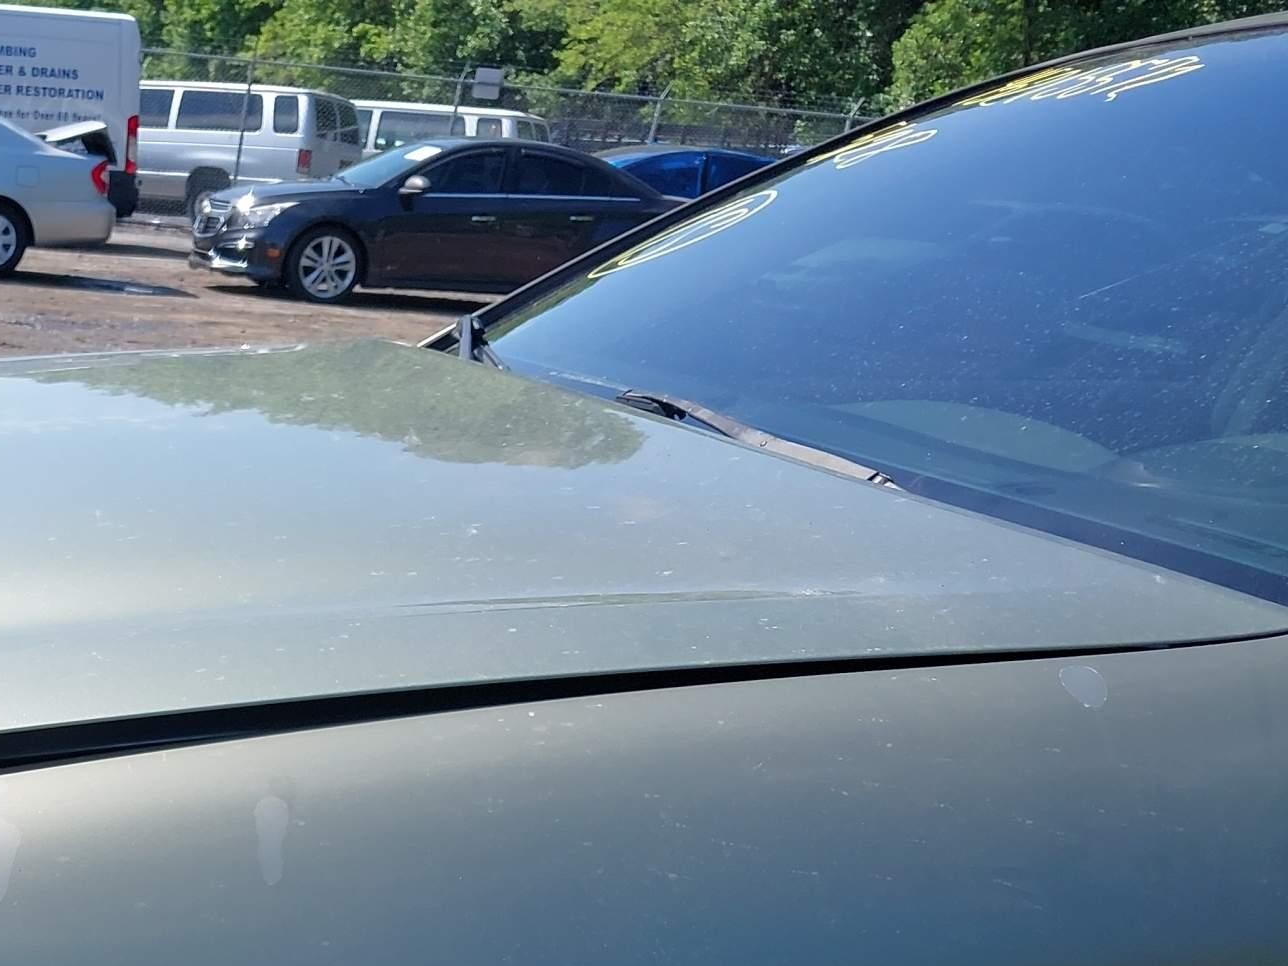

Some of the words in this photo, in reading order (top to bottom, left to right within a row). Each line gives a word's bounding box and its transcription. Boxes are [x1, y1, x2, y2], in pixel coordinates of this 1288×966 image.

[18, 66, 26, 76] &
[32, 67, 79, 81] DRAINS
[16, 85, 105, 101] RESTORATION
